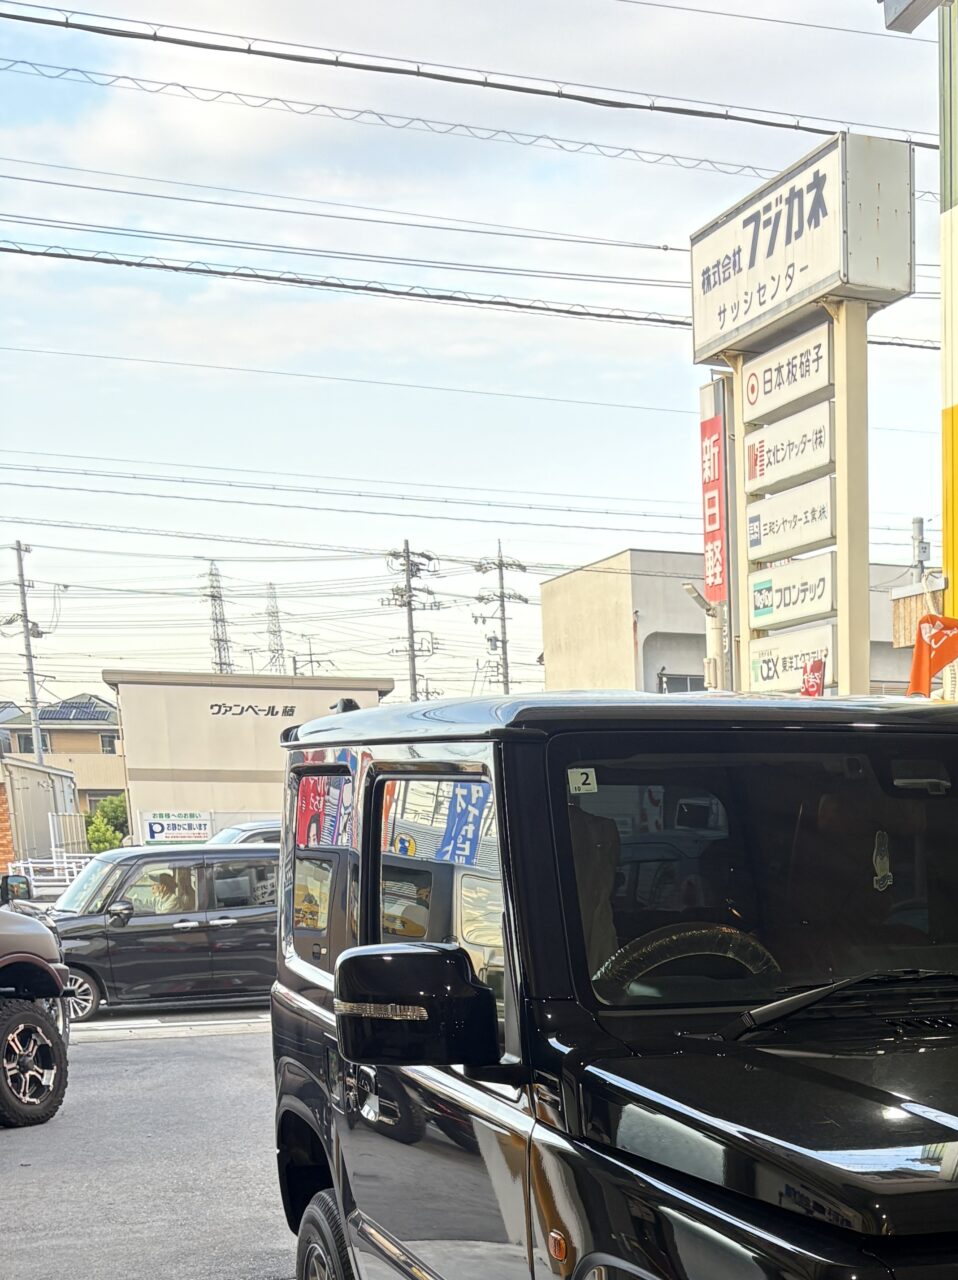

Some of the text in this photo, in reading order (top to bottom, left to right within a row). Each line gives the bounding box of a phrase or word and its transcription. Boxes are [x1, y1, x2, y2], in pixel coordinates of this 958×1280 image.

[701, 168, 829, 296] 株式会社 フジカネ
[717, 263, 809, 330] サッシセンター
[763, 342, 823, 396] 日本板硝子
[702, 433, 723, 587] 新日軽
[775, 577, 826, 609] フロンテック
[580, 772, 592, 786] 2
